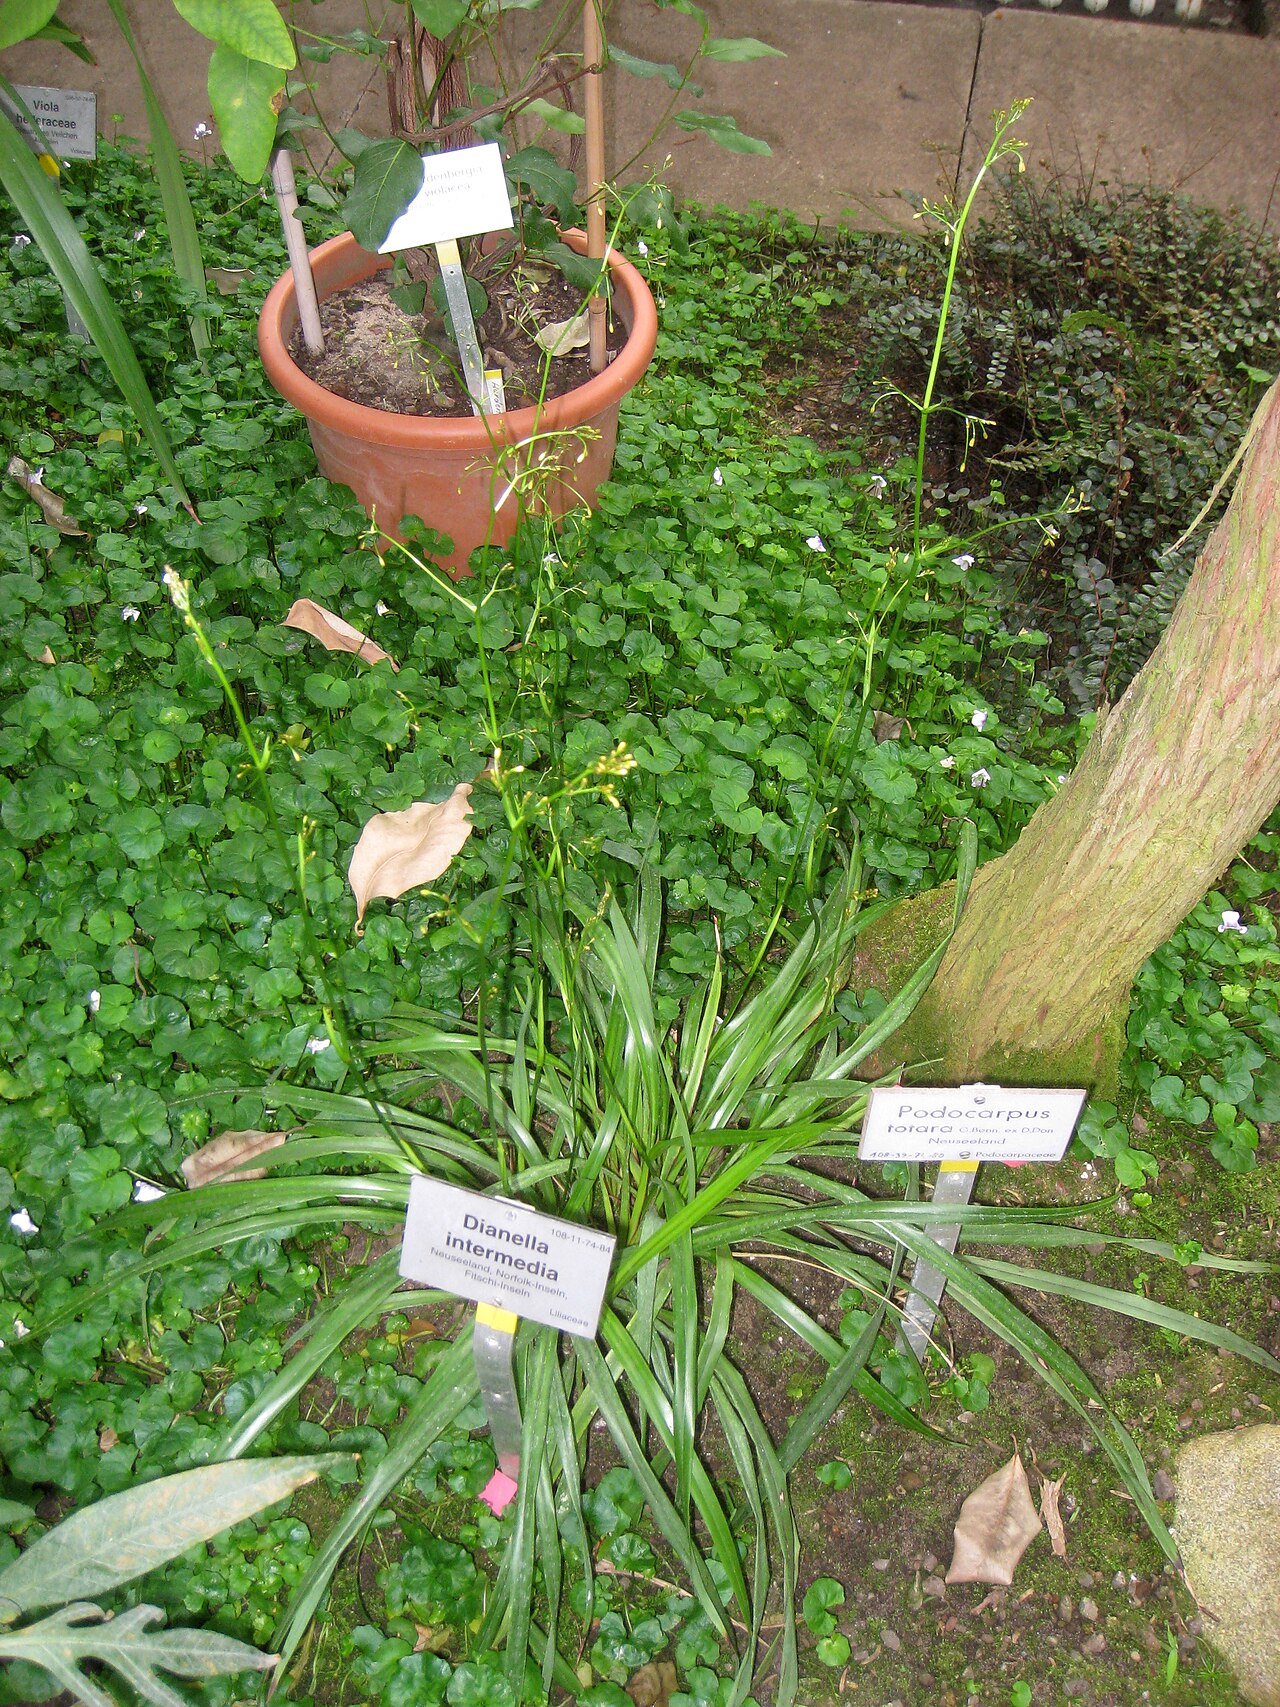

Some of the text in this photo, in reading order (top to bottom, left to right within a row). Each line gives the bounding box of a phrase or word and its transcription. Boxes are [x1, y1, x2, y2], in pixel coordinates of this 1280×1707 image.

[33, 100, 60, 113] Viola
[16, 113, 77, 129] heeraceae
[426, 165, 483, 183] denbergia
[424, 182, 471, 197] violacea
[898, 1105, 1051, 1121] Podocarpus
[887, 1124, 953, 1133] totara
[1021, 1126, 1054, 1134] D.Don
[928, 1137, 1006, 1145] Neuseeland
[975, 1151, 1057, 1159] Podocarpaceae
[463, 1214, 549, 1255] Dianella
[550, 1228, 611, 1254] 108-11-74-84
[445, 1232, 559, 1282] intermedia
[430, 1246, 568, 1300] Neuseeland, Norfolk-Inseln,
[549, 1308, 589, 1327] Liliaceae
